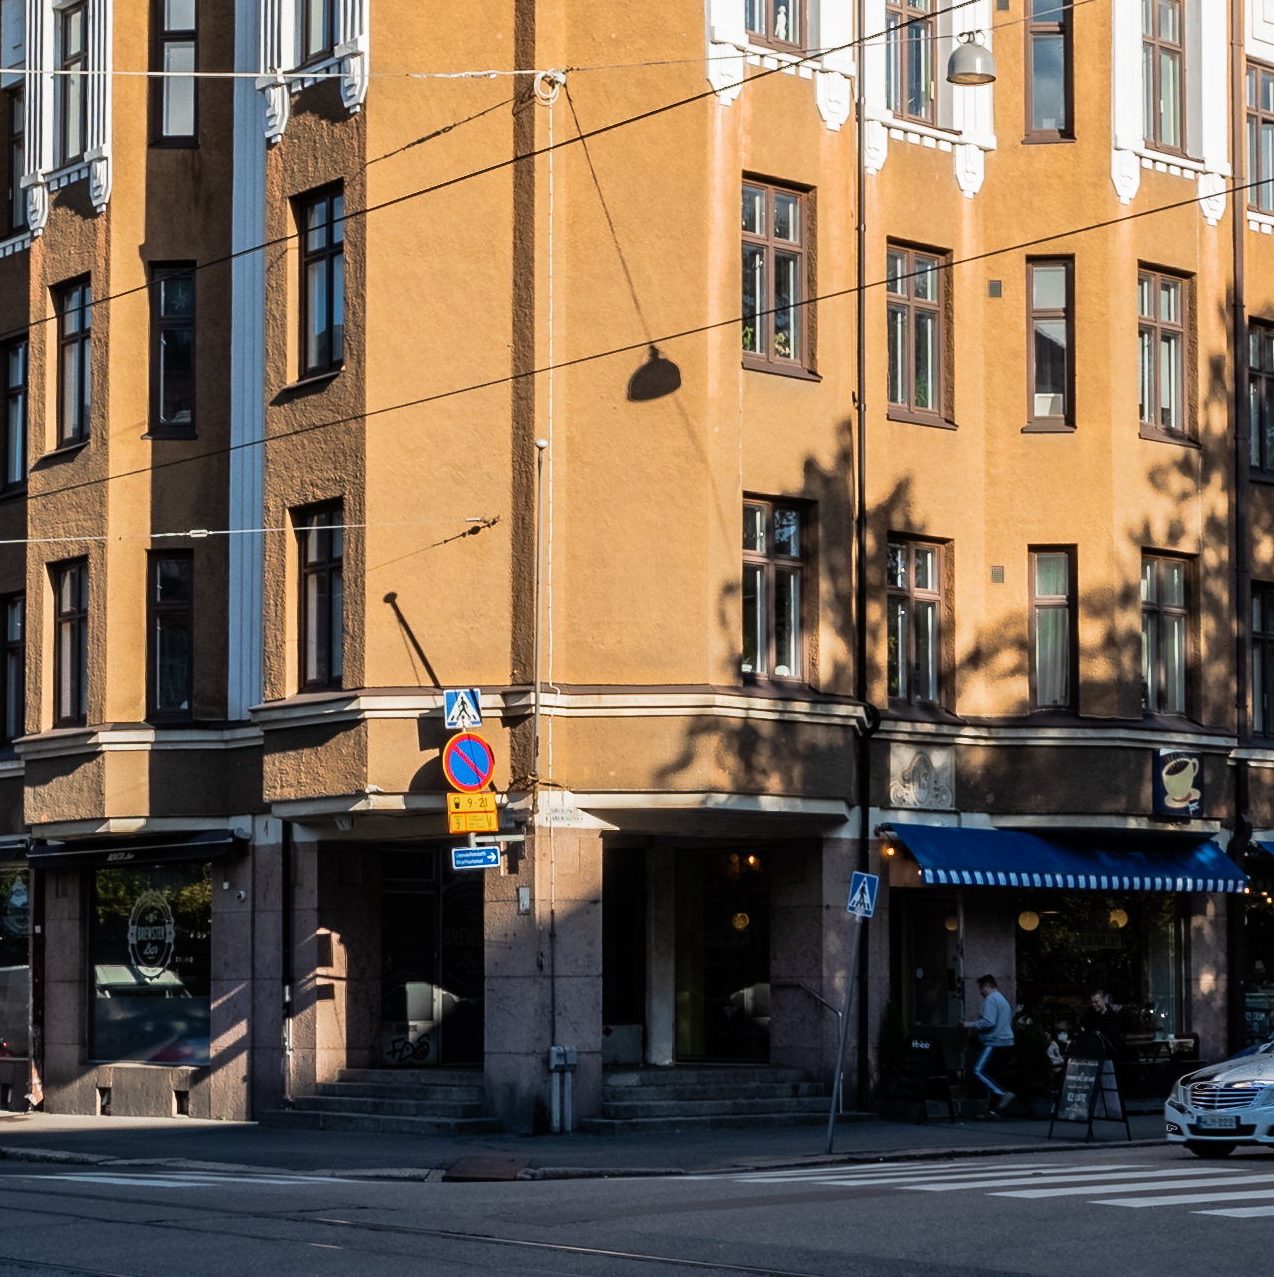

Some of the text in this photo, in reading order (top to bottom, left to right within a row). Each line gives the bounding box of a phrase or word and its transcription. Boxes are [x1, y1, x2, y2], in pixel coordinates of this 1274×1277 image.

[467, 797, 473, 809] 9
[478, 797, 488, 808] 21
[137, 926, 165, 941] BREWSTER
[143, 942, 159, 955] Bar
